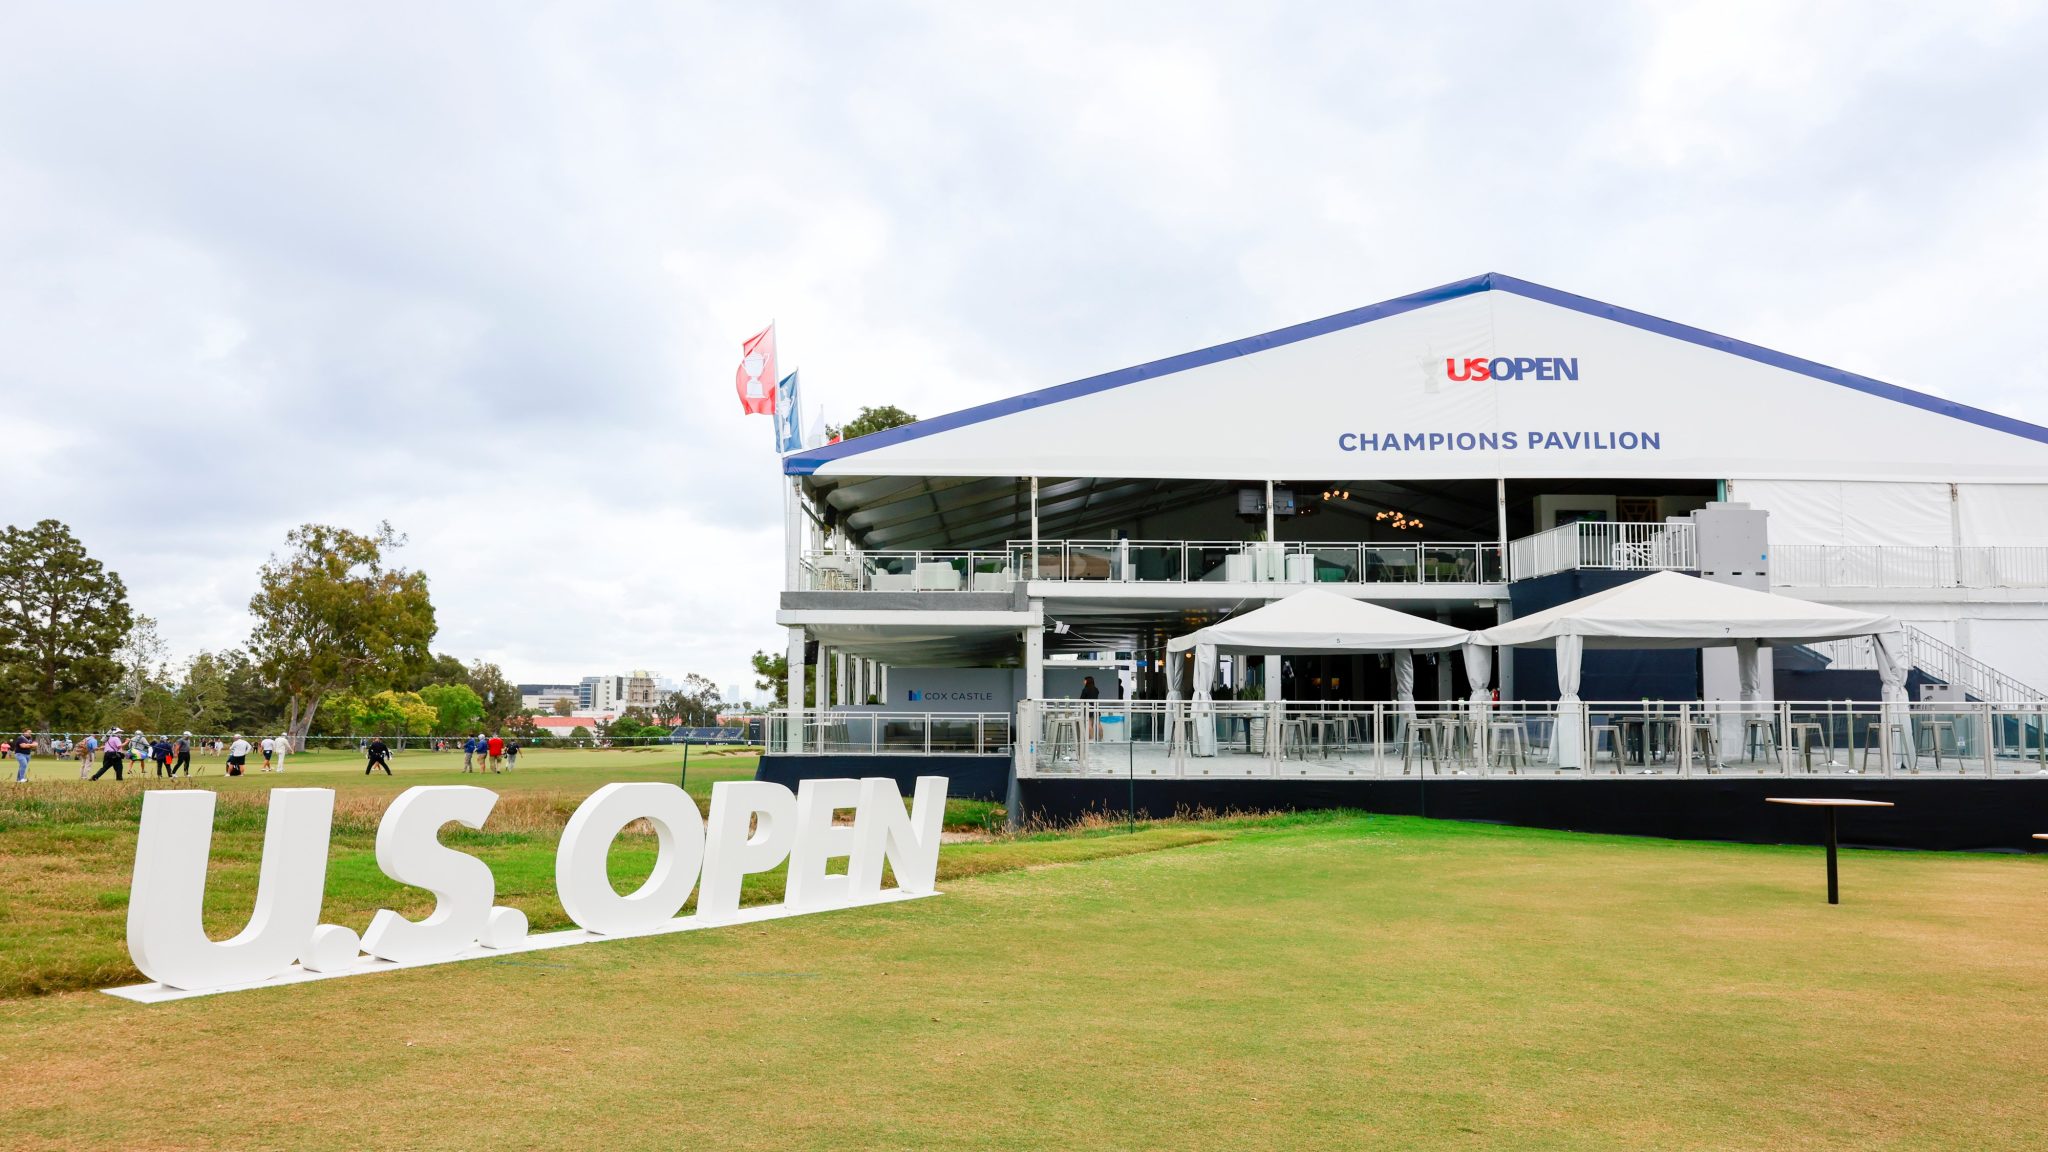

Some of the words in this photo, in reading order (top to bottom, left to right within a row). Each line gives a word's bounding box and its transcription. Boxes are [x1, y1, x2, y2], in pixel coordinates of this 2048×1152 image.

[1338, 431, 1518, 451] CHAMPIONS
[1528, 431, 1662, 450] PAVILION
[924, 692, 948, 701] COX
[951, 692, 993, 701] CASTLE
[127, 785, 529, 991] U.S.
[556, 776, 949, 935] OPEN
